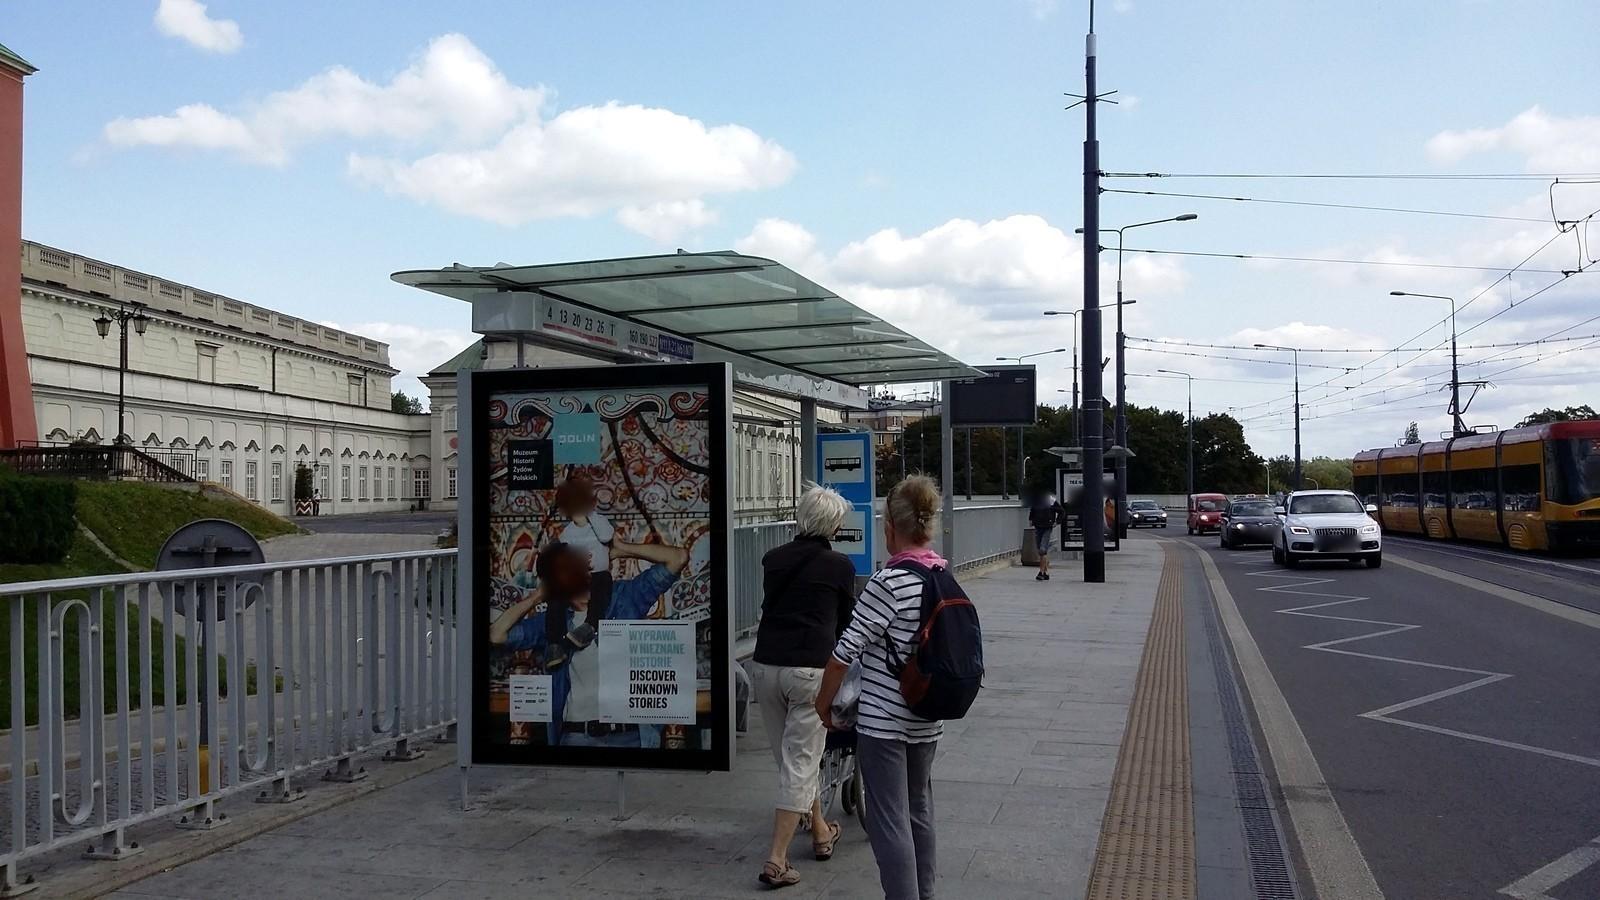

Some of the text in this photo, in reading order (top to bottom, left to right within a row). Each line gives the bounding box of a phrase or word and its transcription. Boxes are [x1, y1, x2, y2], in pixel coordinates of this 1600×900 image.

[559, 309, 568, 323] 13
[572, 313, 581, 327] 20
[585, 317, 593, 331] 23
[596, 321, 605, 334] 26
[629, 630, 677, 641] WYPRAWA
[629, 643, 686, 655] W NIEZNANE
[629, 656, 672, 668] HISTORIE
[630, 670, 676, 681] DISCOVER
[629, 683, 678, 695] UNKNOWN
[629, 697, 668, 709] STORIES
